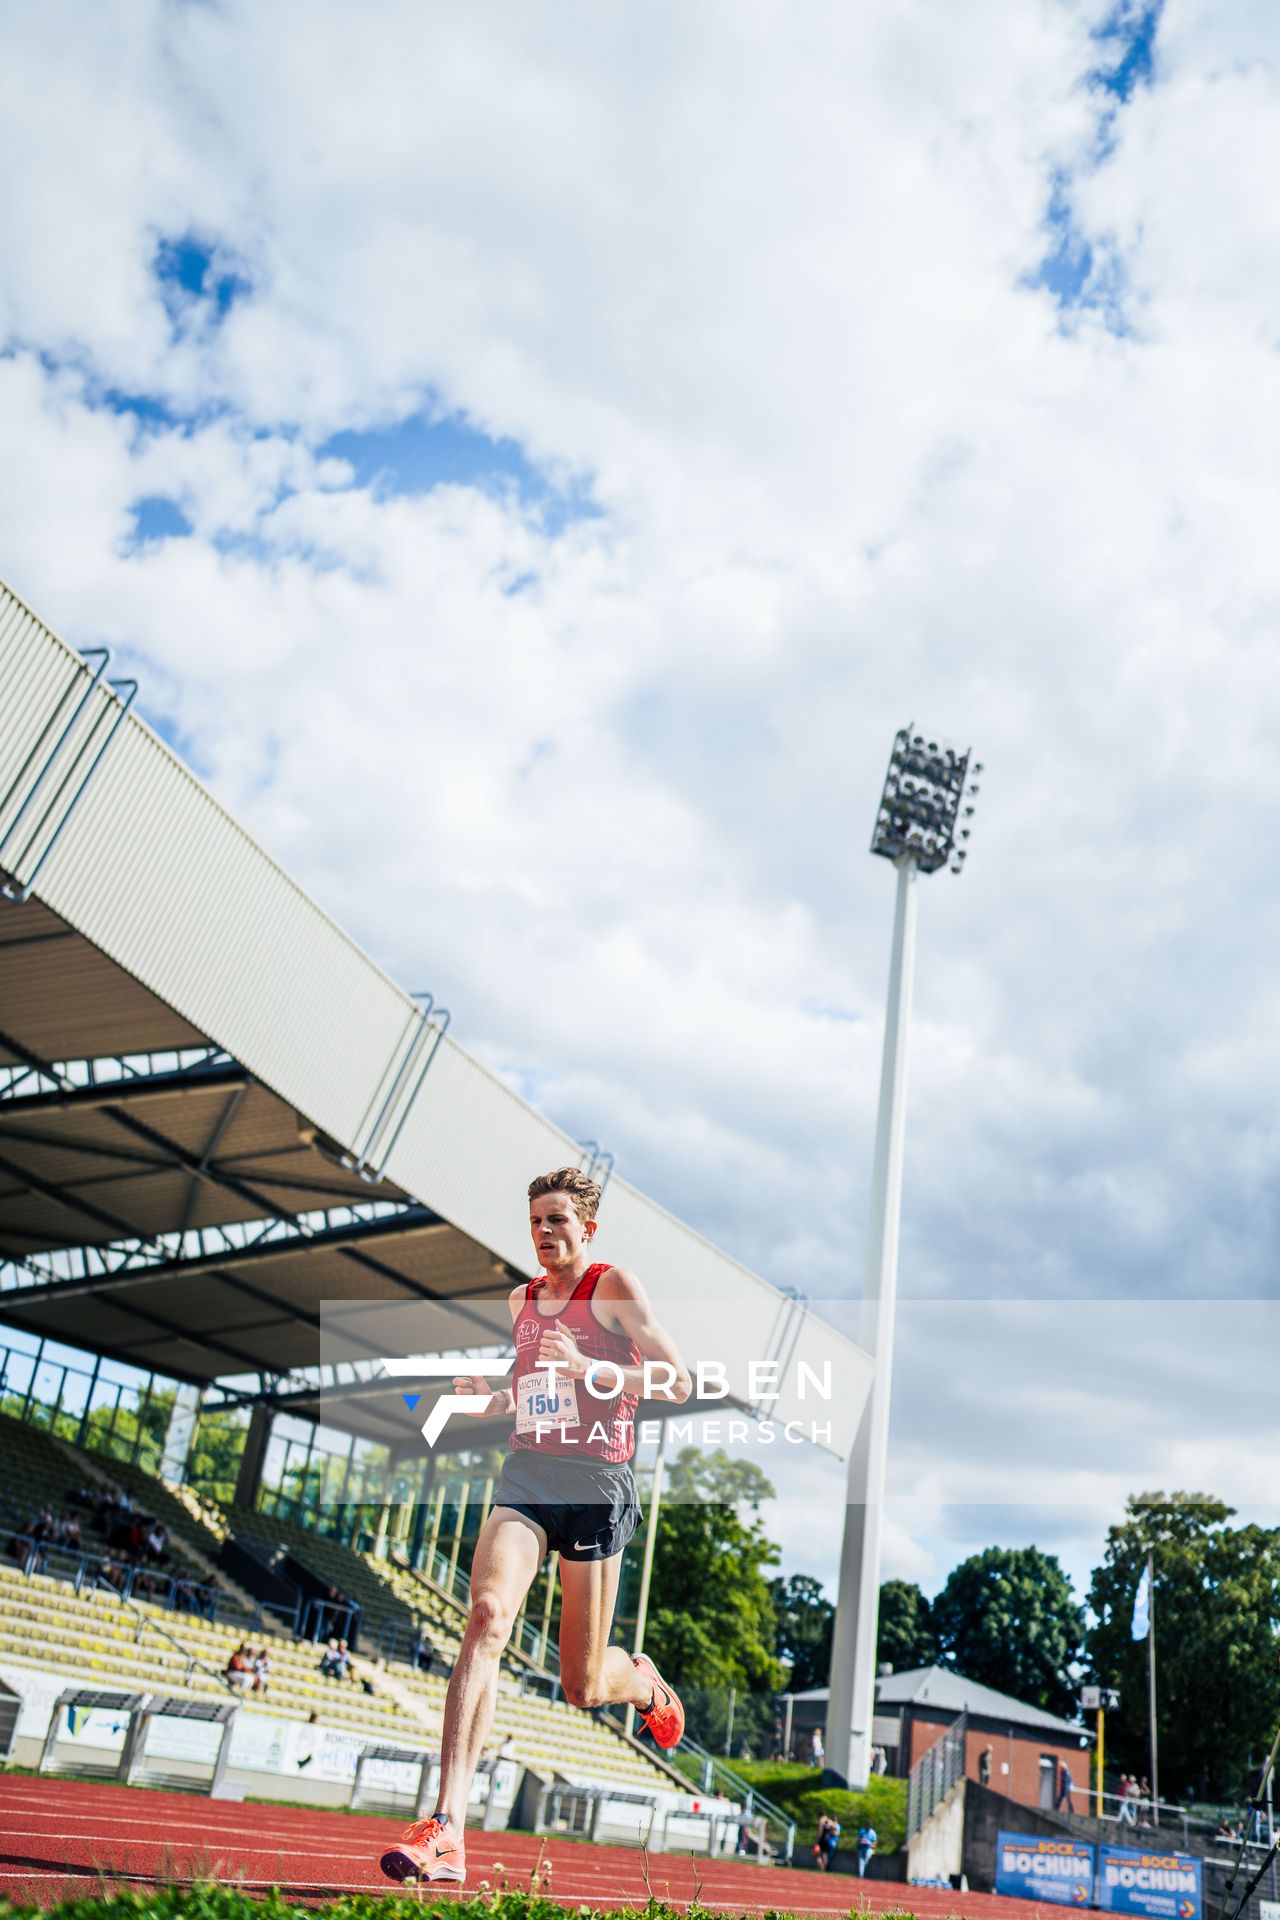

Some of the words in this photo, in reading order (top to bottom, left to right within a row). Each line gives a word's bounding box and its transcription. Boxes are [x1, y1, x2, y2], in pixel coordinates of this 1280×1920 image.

[527, 1393, 559, 1416] 150
[1037, 1841, 1075, 1856] BOCK
[1002, 1851, 1091, 1878] BOCHUM
[1141, 1855, 1179, 1870] BOCK
[1105, 1865, 1198, 1893] BOCHUM
